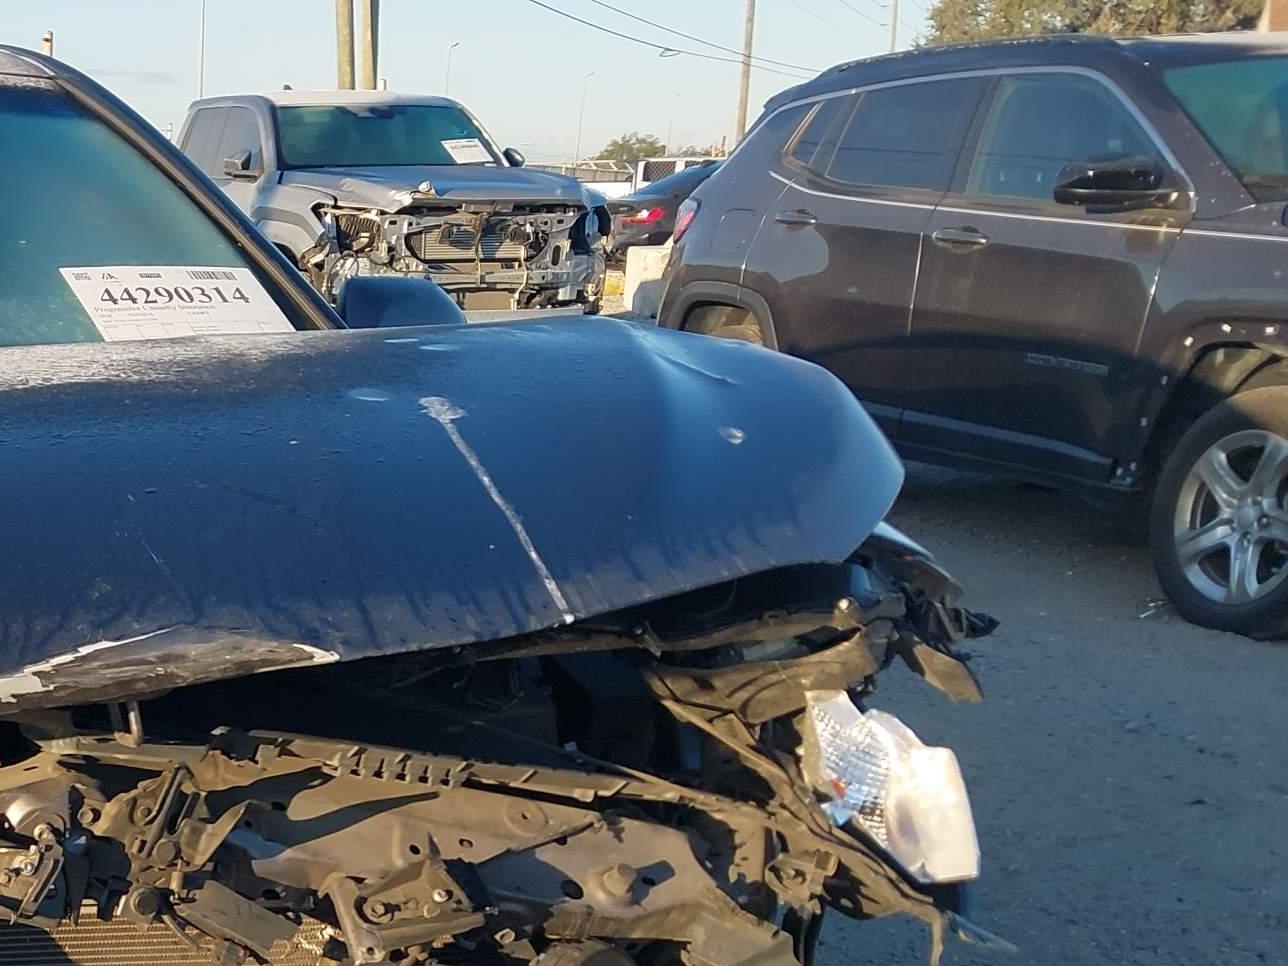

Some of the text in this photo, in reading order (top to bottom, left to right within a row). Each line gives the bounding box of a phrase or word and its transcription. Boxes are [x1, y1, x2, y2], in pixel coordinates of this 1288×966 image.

[100, 286, 251, 305] 44290314
[94, 305, 141, 313] Progressive
[142, 304, 177, 312] Casualty
